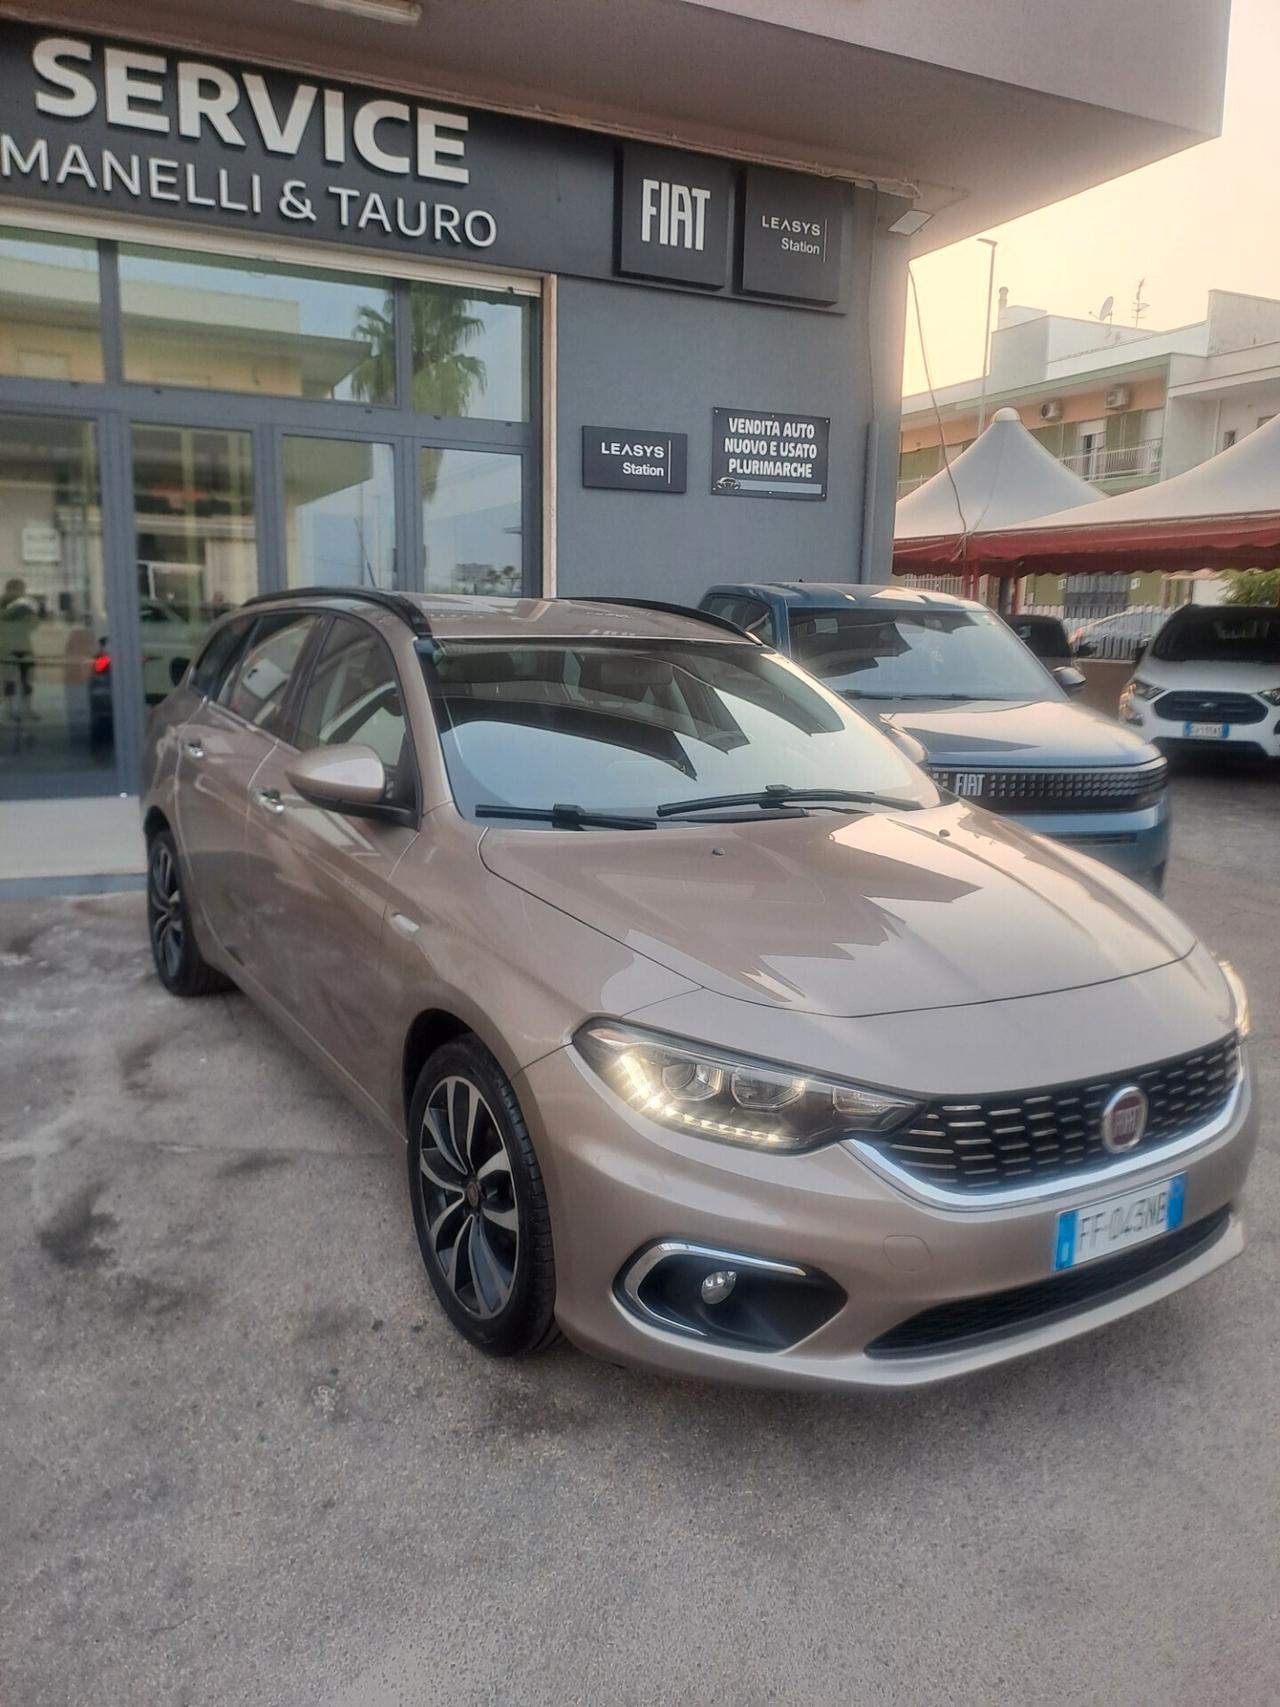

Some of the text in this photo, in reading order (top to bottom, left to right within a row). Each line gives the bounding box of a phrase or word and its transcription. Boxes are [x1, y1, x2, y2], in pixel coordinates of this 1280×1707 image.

[32, 37, 470, 184] SERVICE
[0, 134, 498, 248] MANELLI & TAURO
[641, 178, 711, 251] FIAT
[761, 215, 821, 236] LEASYS
[781, 237, 820, 255] Station
[728, 417, 815, 439] VENDITA AUTO
[601, 442, 664, 458] LEASYS
[724, 438, 817, 459] NUOVO E USATO
[622, 462, 664, 477] Station
[728, 458, 813, 478] PLURIMARCHE
[955, 773, 985, 796] FIAT
